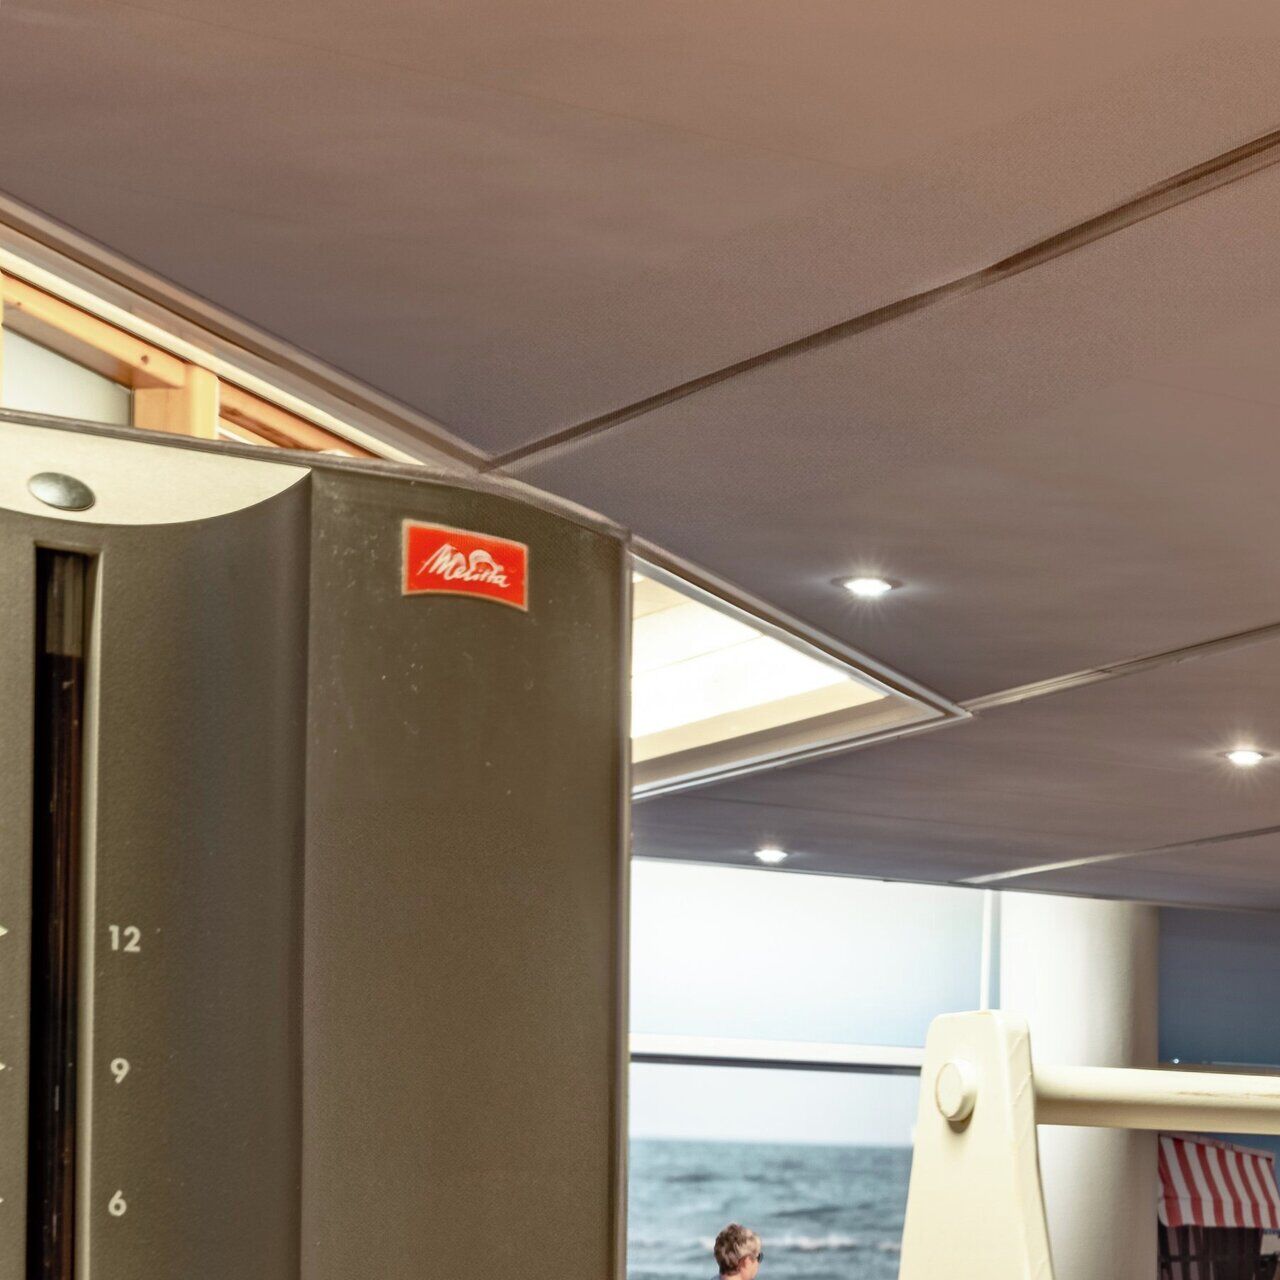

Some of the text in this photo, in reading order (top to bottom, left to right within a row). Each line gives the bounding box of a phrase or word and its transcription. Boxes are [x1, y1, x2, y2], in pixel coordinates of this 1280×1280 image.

[108, 924, 142, 953] 12
[110, 1057, 130, 1084] 9
[108, 1190, 127, 1217] 6
